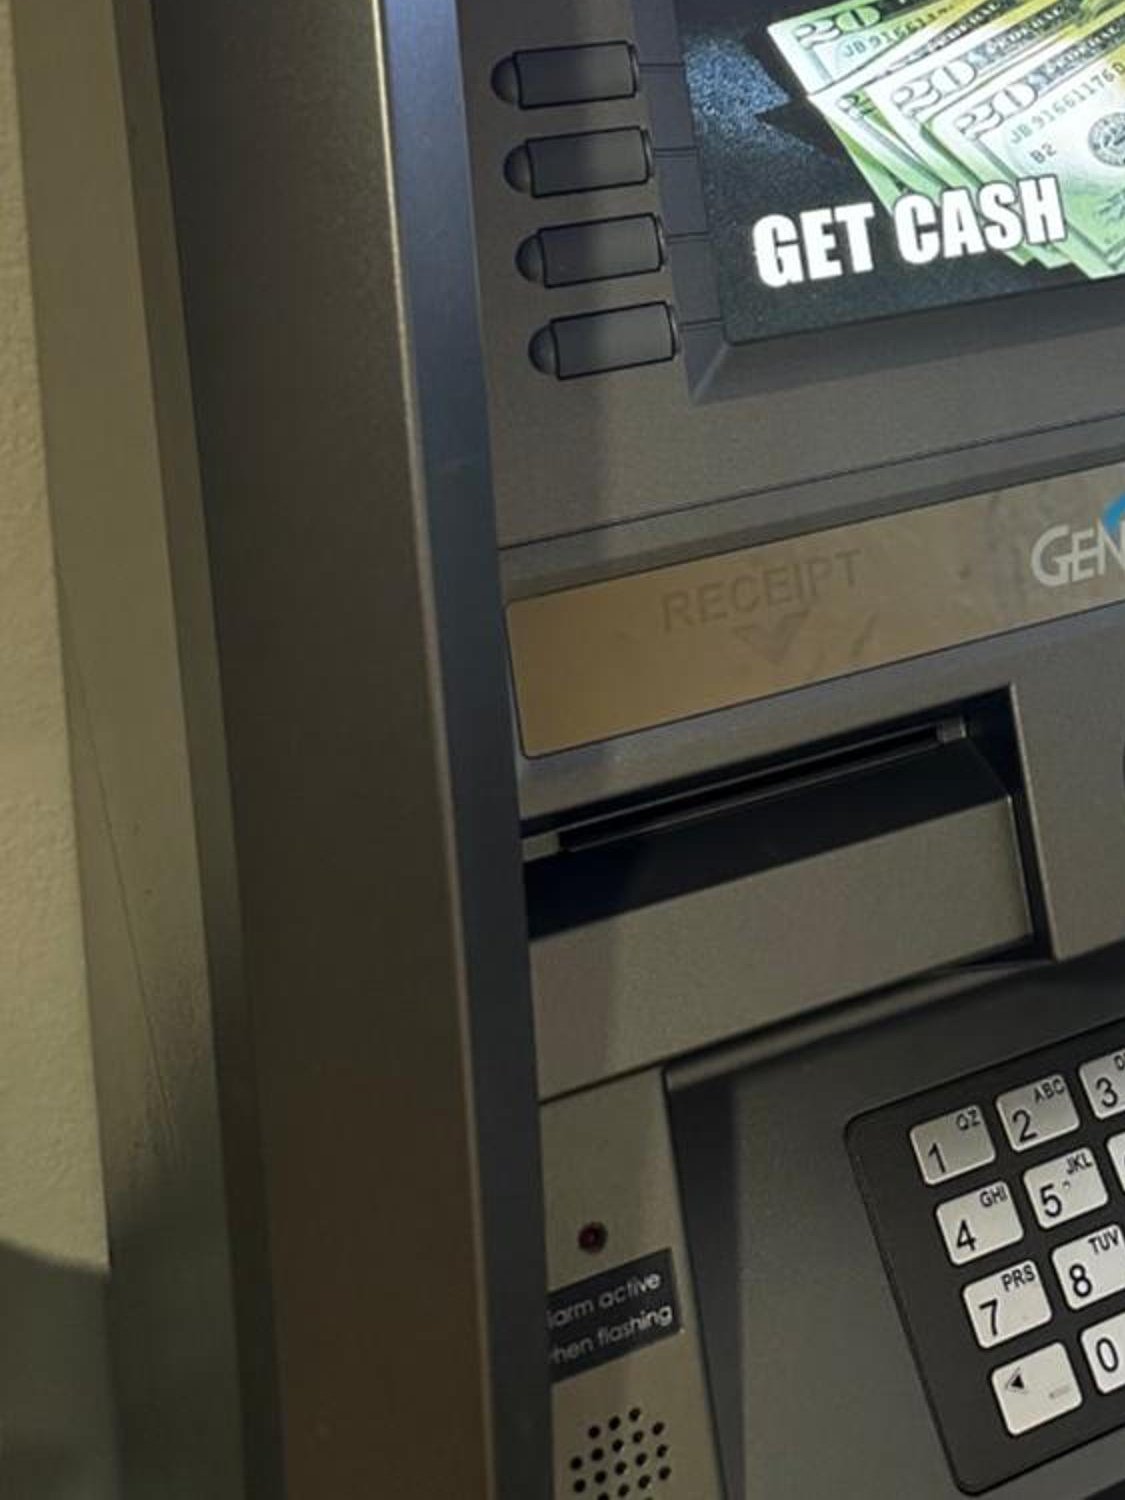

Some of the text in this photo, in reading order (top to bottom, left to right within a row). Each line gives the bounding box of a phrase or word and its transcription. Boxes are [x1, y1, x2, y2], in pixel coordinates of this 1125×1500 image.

[890, 58, 978, 120] 20
[953, 82, 1040, 140] 20
[751, 202, 875, 288] GET
[894, 174, 1067, 265] CASH
[660, 549, 861, 633] RECEIPT
[1034, 1077, 1065, 1104] ABC
[1095, 1077, 1119, 1108] 3
[955, 1108, 980, 1131] QZ
[1012, 1109, 1037, 1142] 2
[927, 1141, 947, 1174] 1
[1065, 1151, 1093, 1175] JKL
[979, 1188, 1008, 1208] GHI
[1039, 1184, 1063, 1218] 5
[956, 1218, 976, 1252] 4
[1088, 1229, 1120, 1255] TUV
[598, 1274, 661, 1309] active
[1001, 1264, 1037, 1292] PRS
[1068, 1263, 1093, 1298] 8
[598, 1306, 673, 1345] flashing
[979, 1298, 999, 1336] 7
[1095, 1337, 1119, 1373] 0
